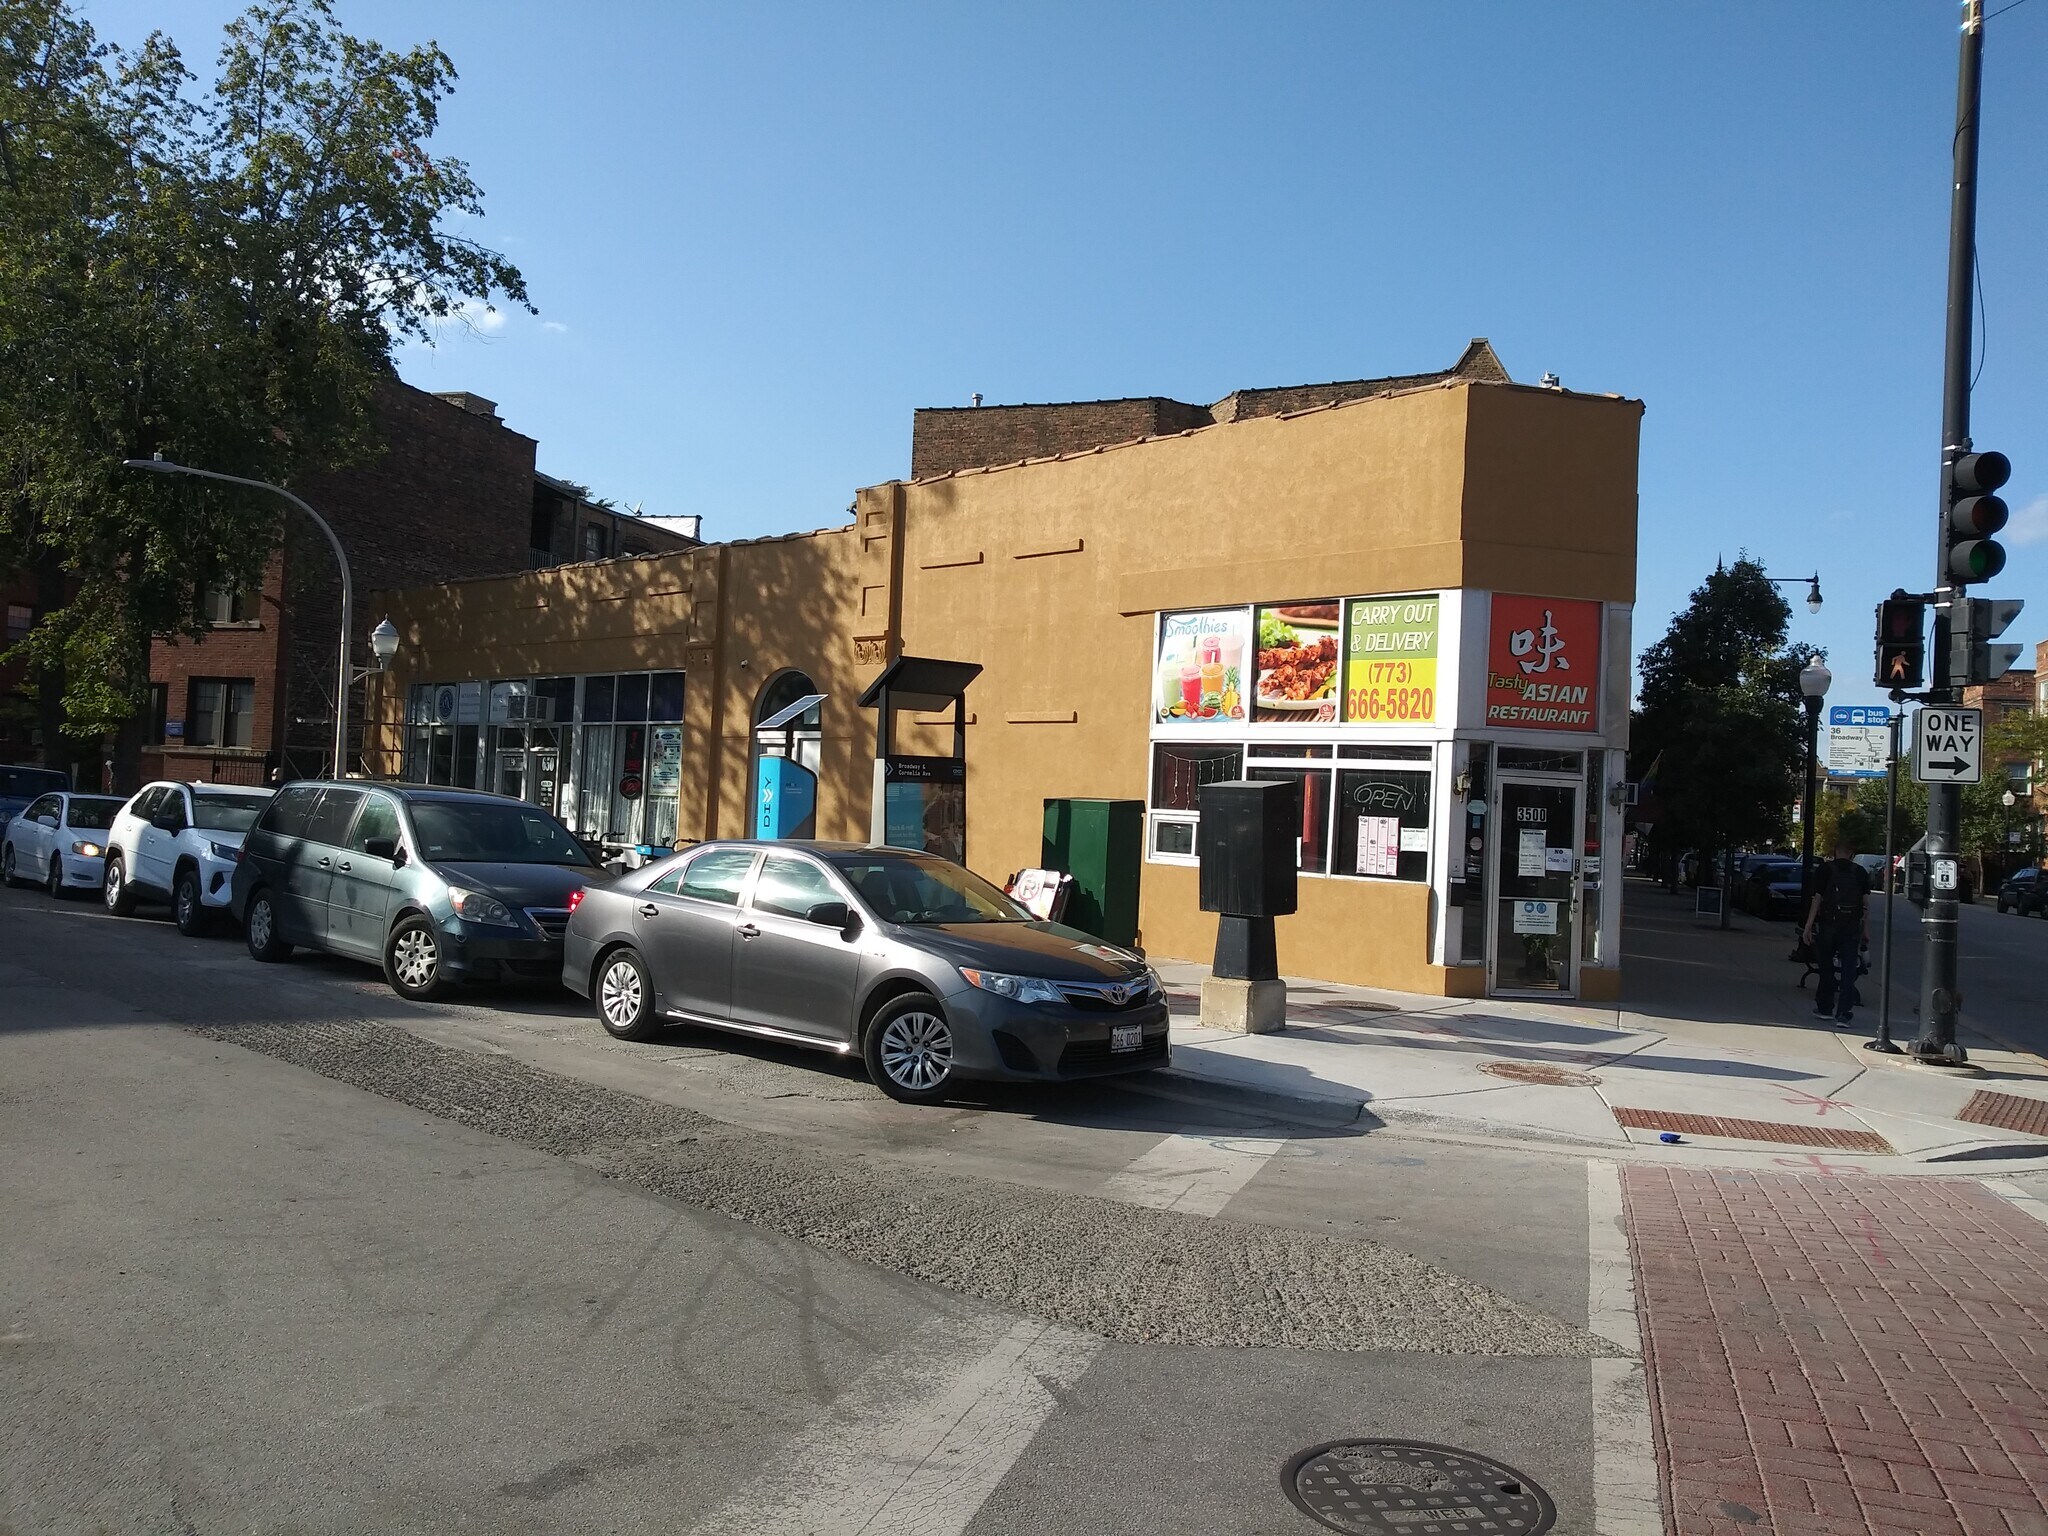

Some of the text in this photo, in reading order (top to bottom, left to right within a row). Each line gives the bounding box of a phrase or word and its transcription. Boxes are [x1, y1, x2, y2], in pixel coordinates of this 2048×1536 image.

[1351, 603, 1437, 625] CARRY OUT
[1166, 617, 1228, 638] Smoothies
[1350, 631, 1435, 653] & DELIVERY
[1511, 610, 1570, 674] 味
[1368, 662, 1413, 684] (773)
[1488, 672, 1588, 704] Tasty ASIAN
[1347, 687, 1434, 720] 666-5820
[1867, 709, 1884, 717] bus
[1488, 705, 1590, 724] RESTAURANT
[1867, 717, 1887, 725] stop
[1928, 714, 1974, 732] ONE
[1830, 727, 1841, 735] 36
[1926, 735, 1975, 752] WAY
[541, 756, 555, 772] 650
[1356, 787, 1414, 811] OPEN
[1518, 808, 1546, 821] 3500
